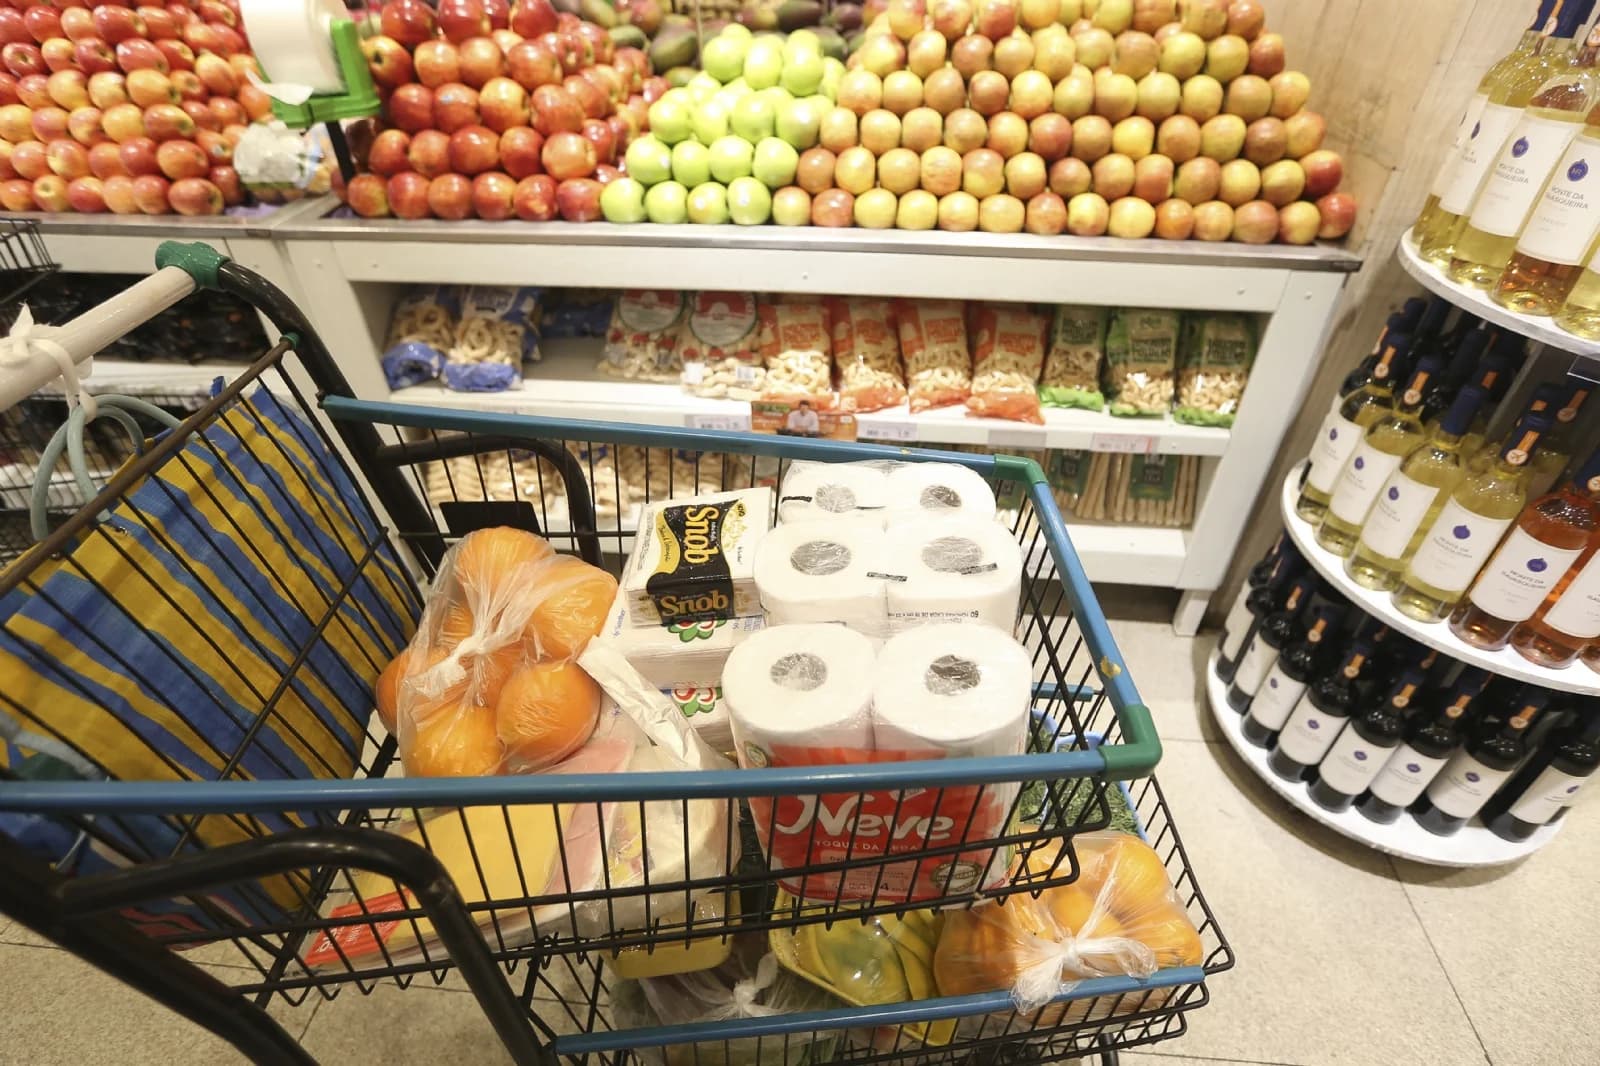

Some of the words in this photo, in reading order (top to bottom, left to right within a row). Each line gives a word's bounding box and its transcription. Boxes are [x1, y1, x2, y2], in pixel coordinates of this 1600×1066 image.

[683, 505, 720, 564] Snob
[660, 590, 729, 617] Snob
[775, 794, 954, 841] Neve
[863, 843, 880, 851] DA
